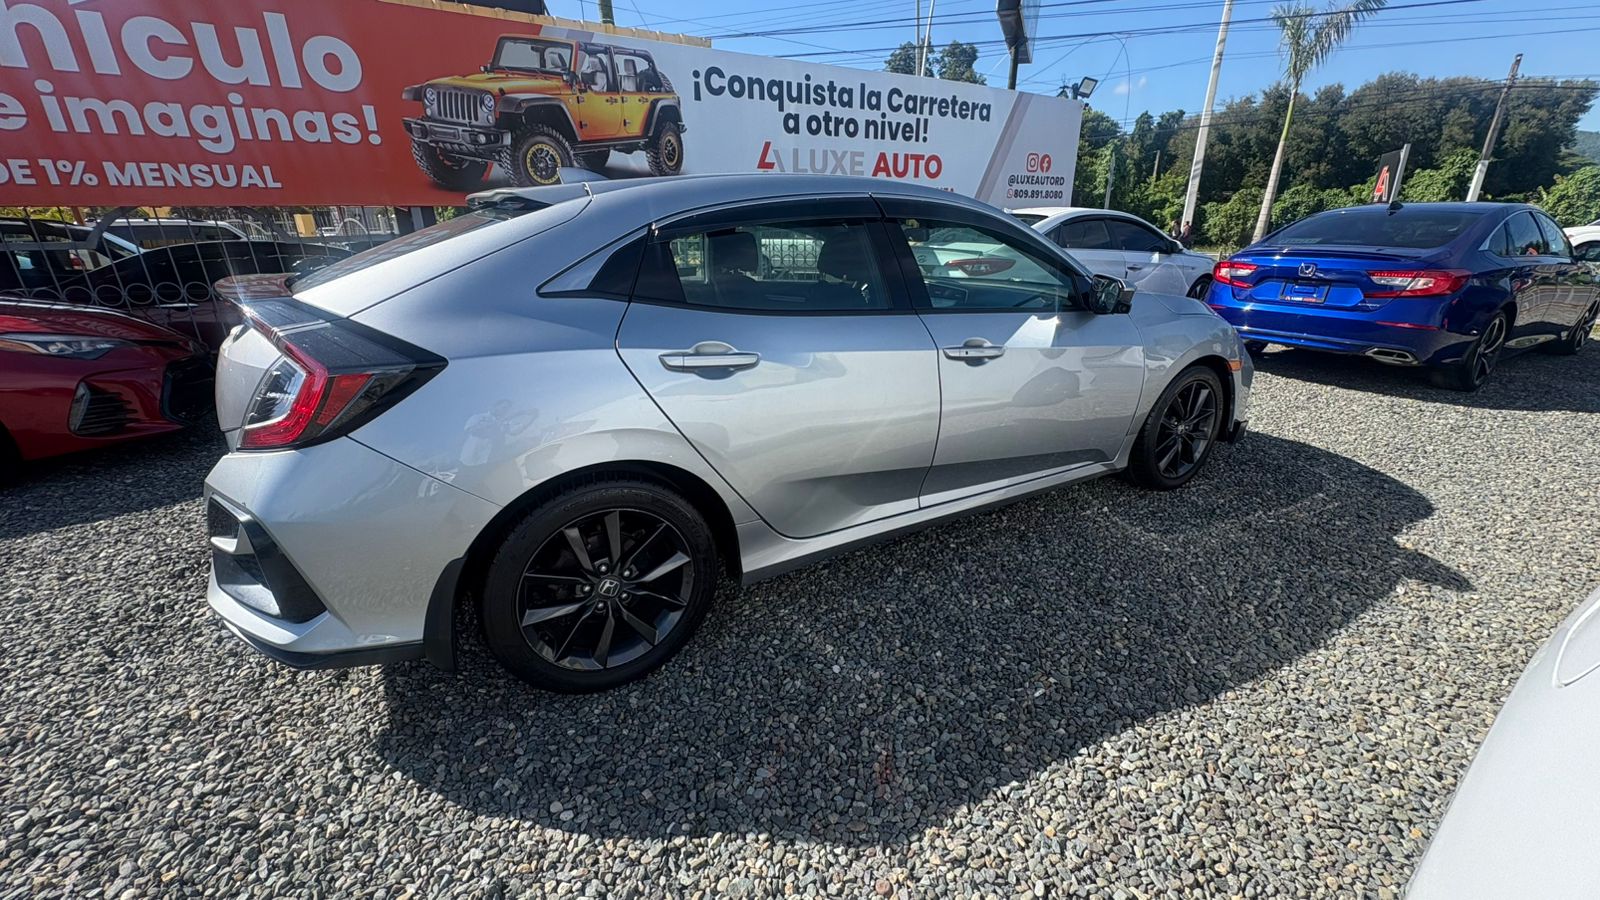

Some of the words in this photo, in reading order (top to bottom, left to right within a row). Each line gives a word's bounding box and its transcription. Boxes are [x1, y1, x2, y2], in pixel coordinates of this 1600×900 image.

[692, 66, 854, 113] ¡Conquista
[859, 82, 882, 112] la
[887, 87, 992, 122] Carretera
[34, 79, 383, 154] imaginas!
[783, 112, 800, 136] a
[806, 111, 859, 138] otro
[864, 112, 929, 143] nivel!
[38, 158, 99, 186] 1%
[102, 161, 282, 188] MENSUAL
[792, 147, 865, 176] LUXE
[871, 151, 943, 179] AUTO
[1007, 174, 1065, 187] @LUXEAUTORD
[1013, 189, 1064, 200] 809.891.8080
